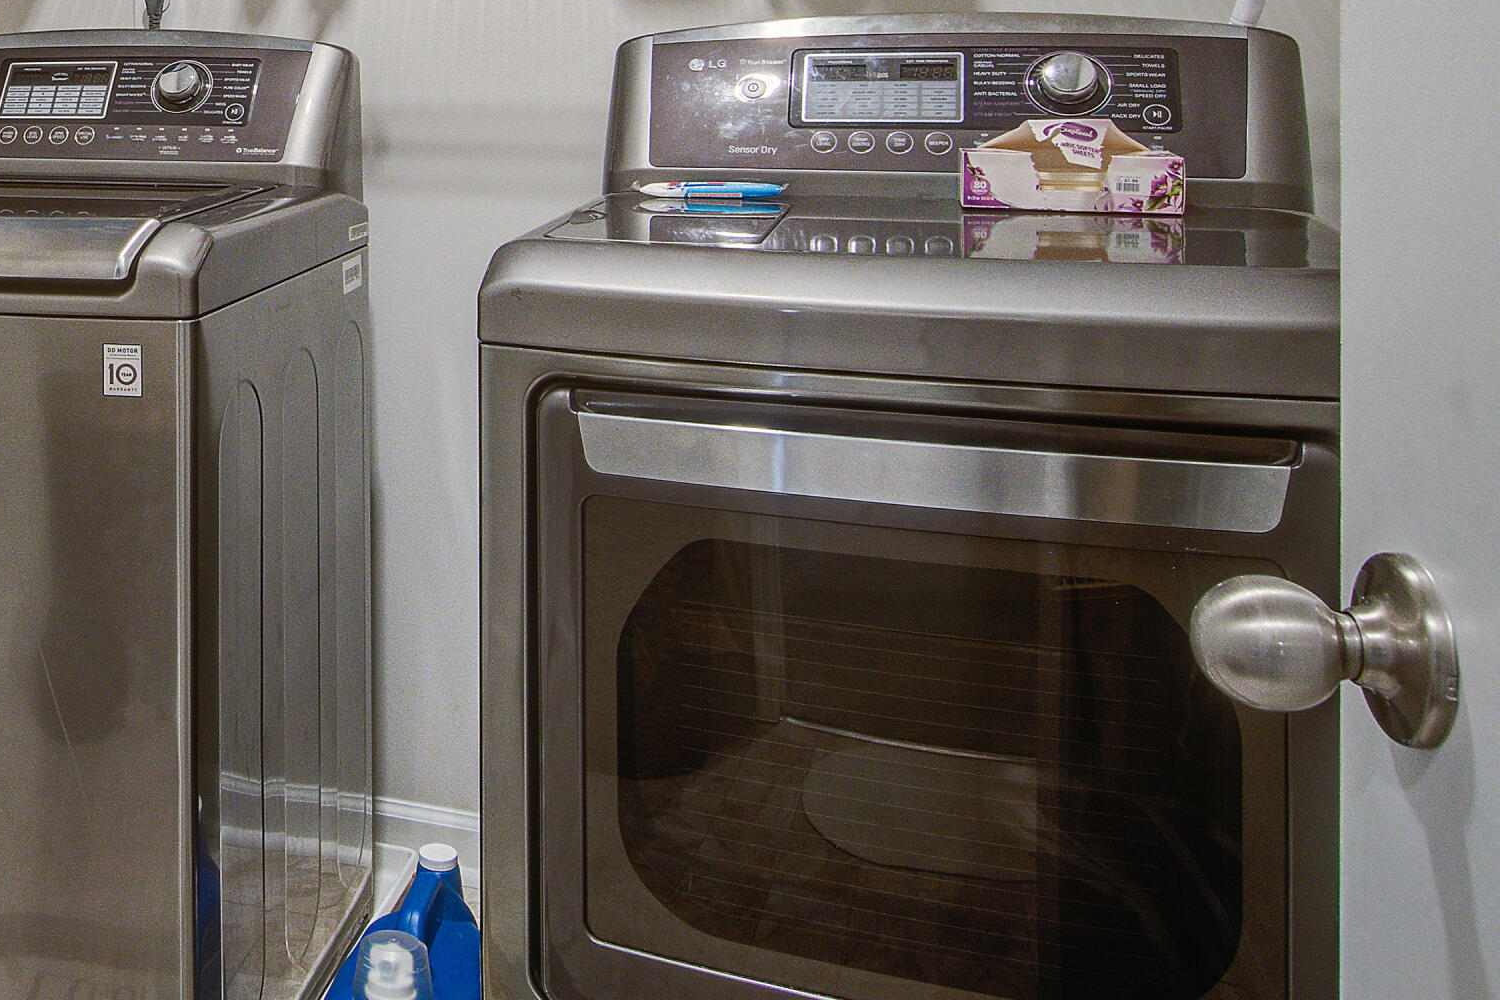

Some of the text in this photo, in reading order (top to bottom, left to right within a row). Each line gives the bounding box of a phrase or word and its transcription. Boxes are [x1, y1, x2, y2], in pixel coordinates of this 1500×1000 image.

[708, 60, 727, 69] LG
[728, 145, 778, 155] Sensor Dry
[973, 181, 987, 189] 80
[108, 363, 138, 386] 10
